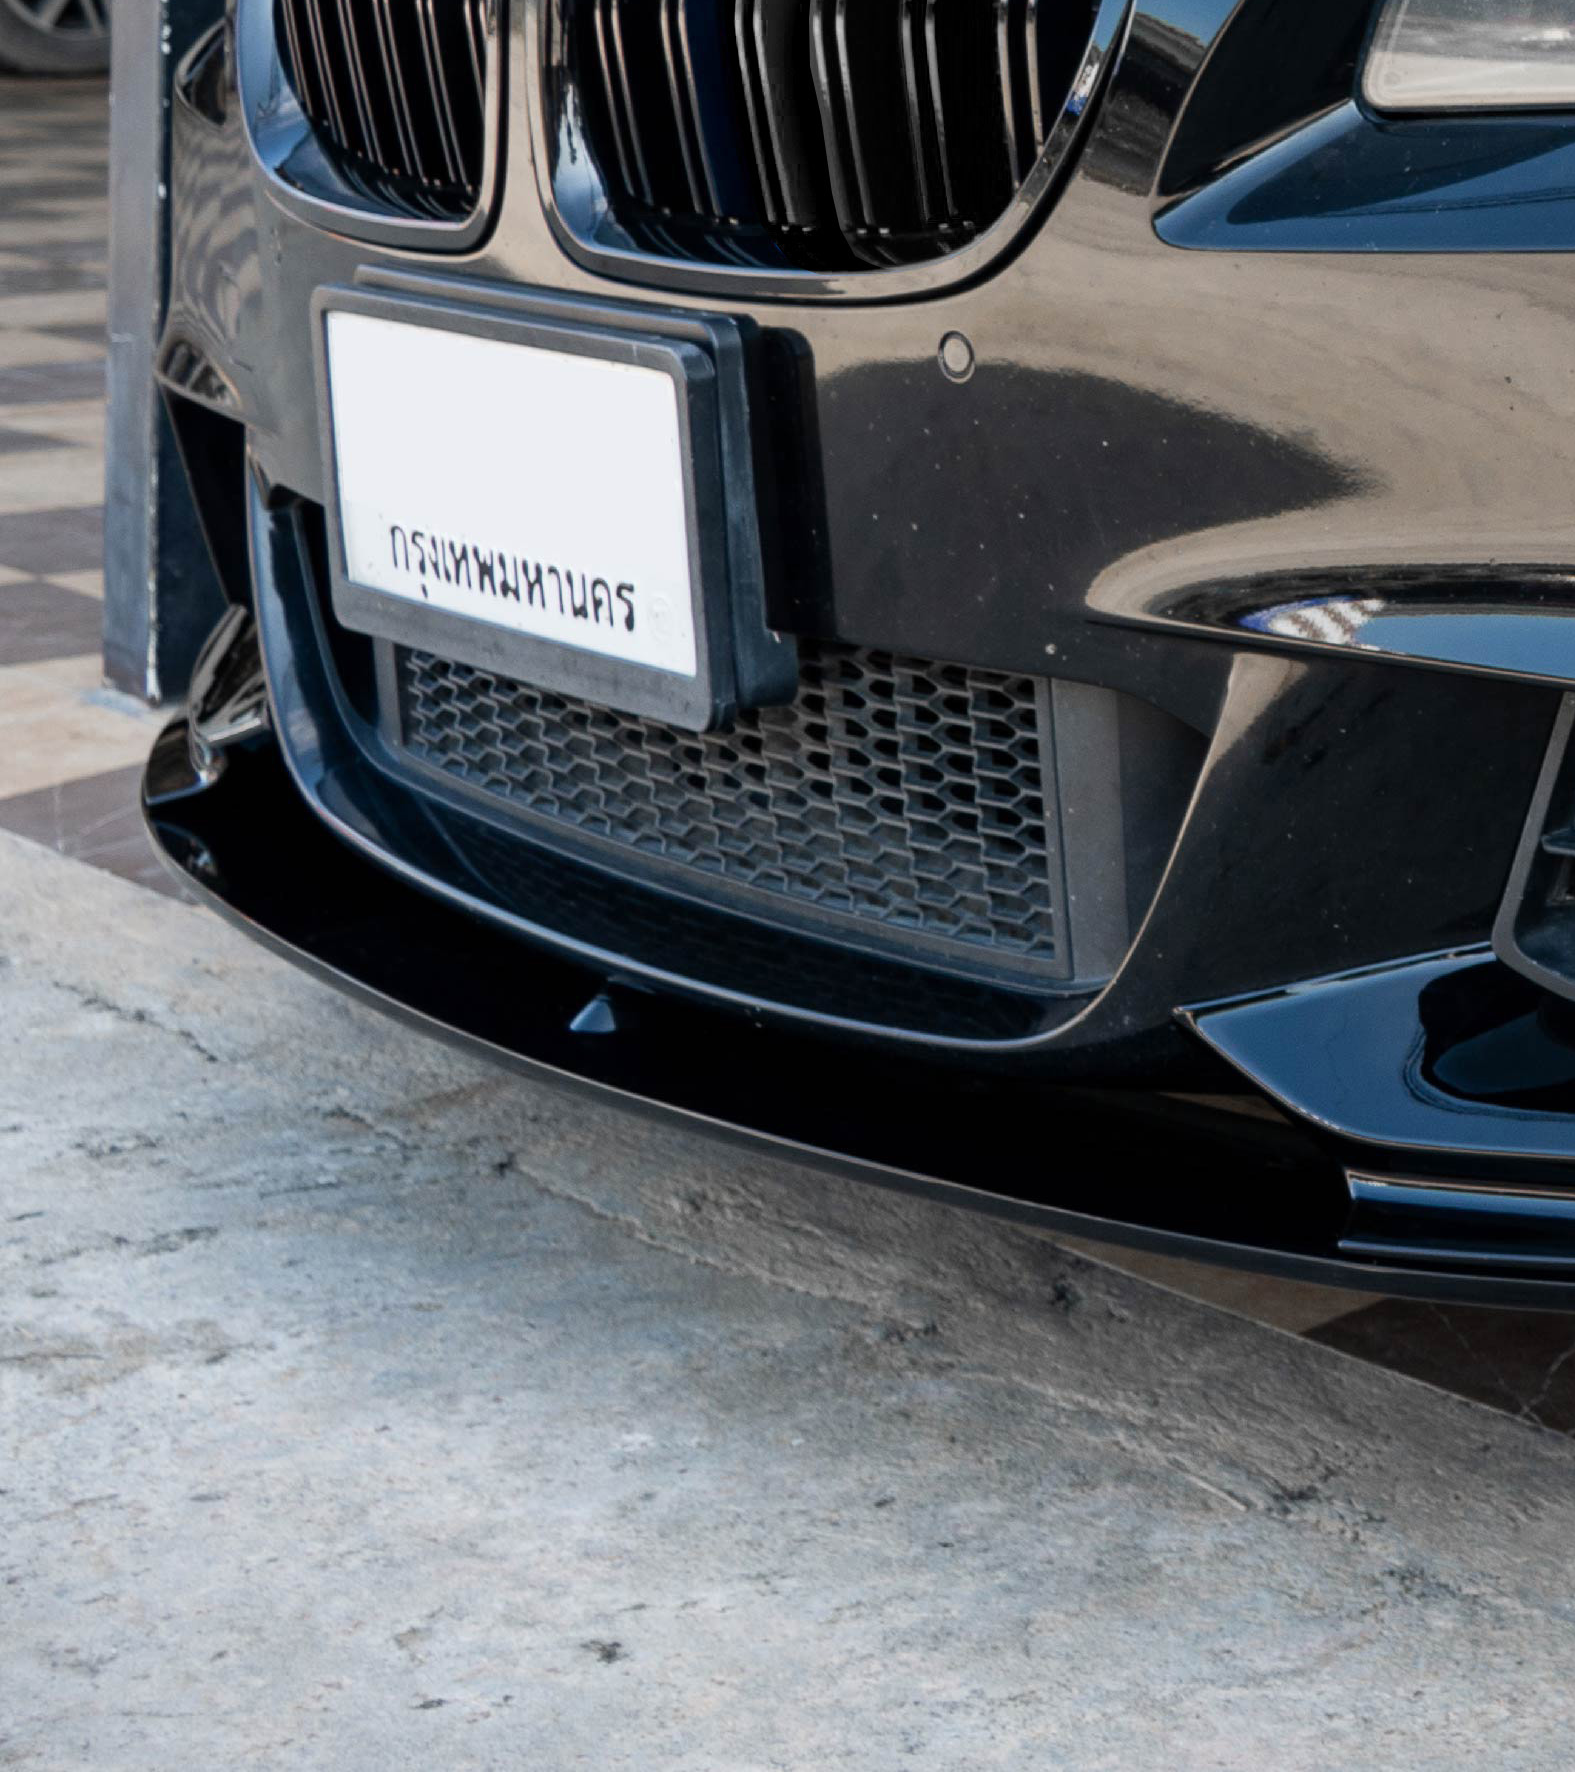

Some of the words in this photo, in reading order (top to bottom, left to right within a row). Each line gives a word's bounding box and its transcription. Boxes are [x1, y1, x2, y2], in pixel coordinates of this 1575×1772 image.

[390, 524, 636, 632] กรุงเทพมหานคร
